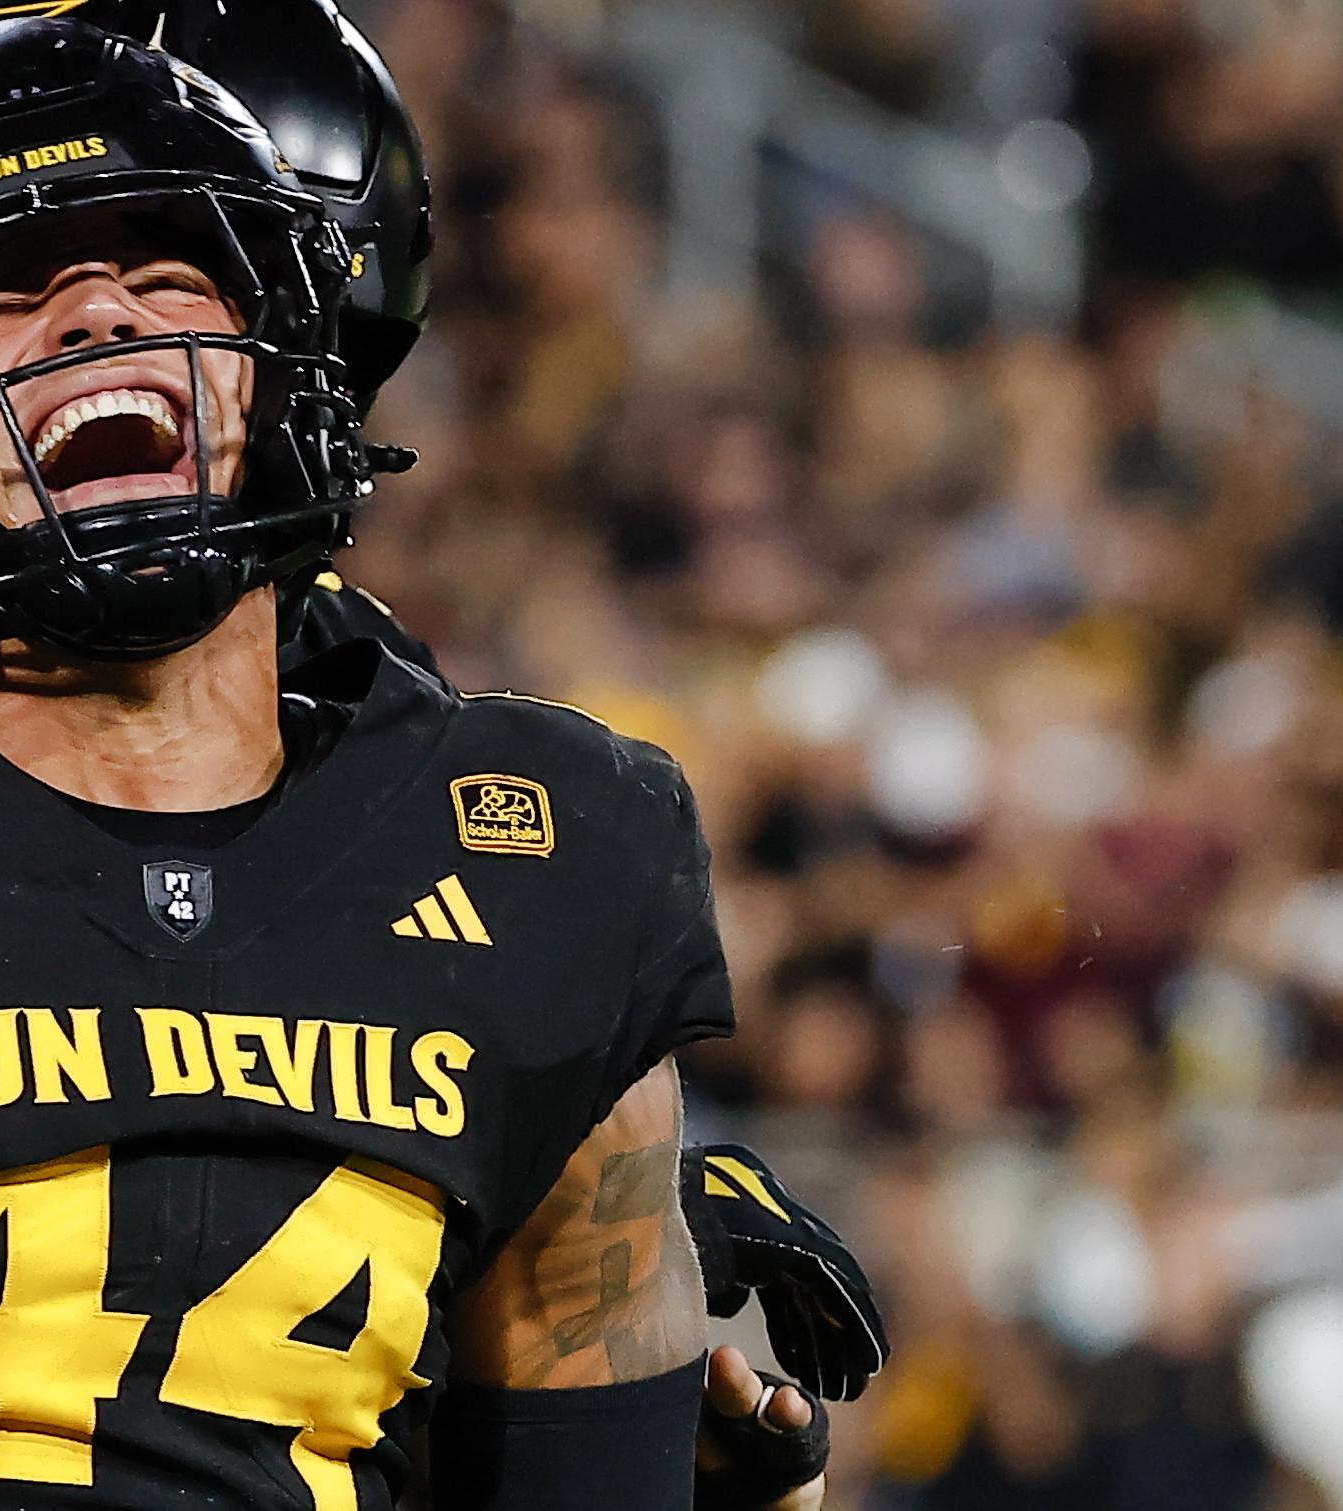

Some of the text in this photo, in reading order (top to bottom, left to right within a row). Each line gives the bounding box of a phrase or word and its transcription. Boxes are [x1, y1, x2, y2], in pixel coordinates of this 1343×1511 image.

[22, 136, 108, 170] DEVILS
[164, 871, 191, 892] PT
[167, 900, 195, 920] 42
[133, 1007, 476, 1138] DEVILS
